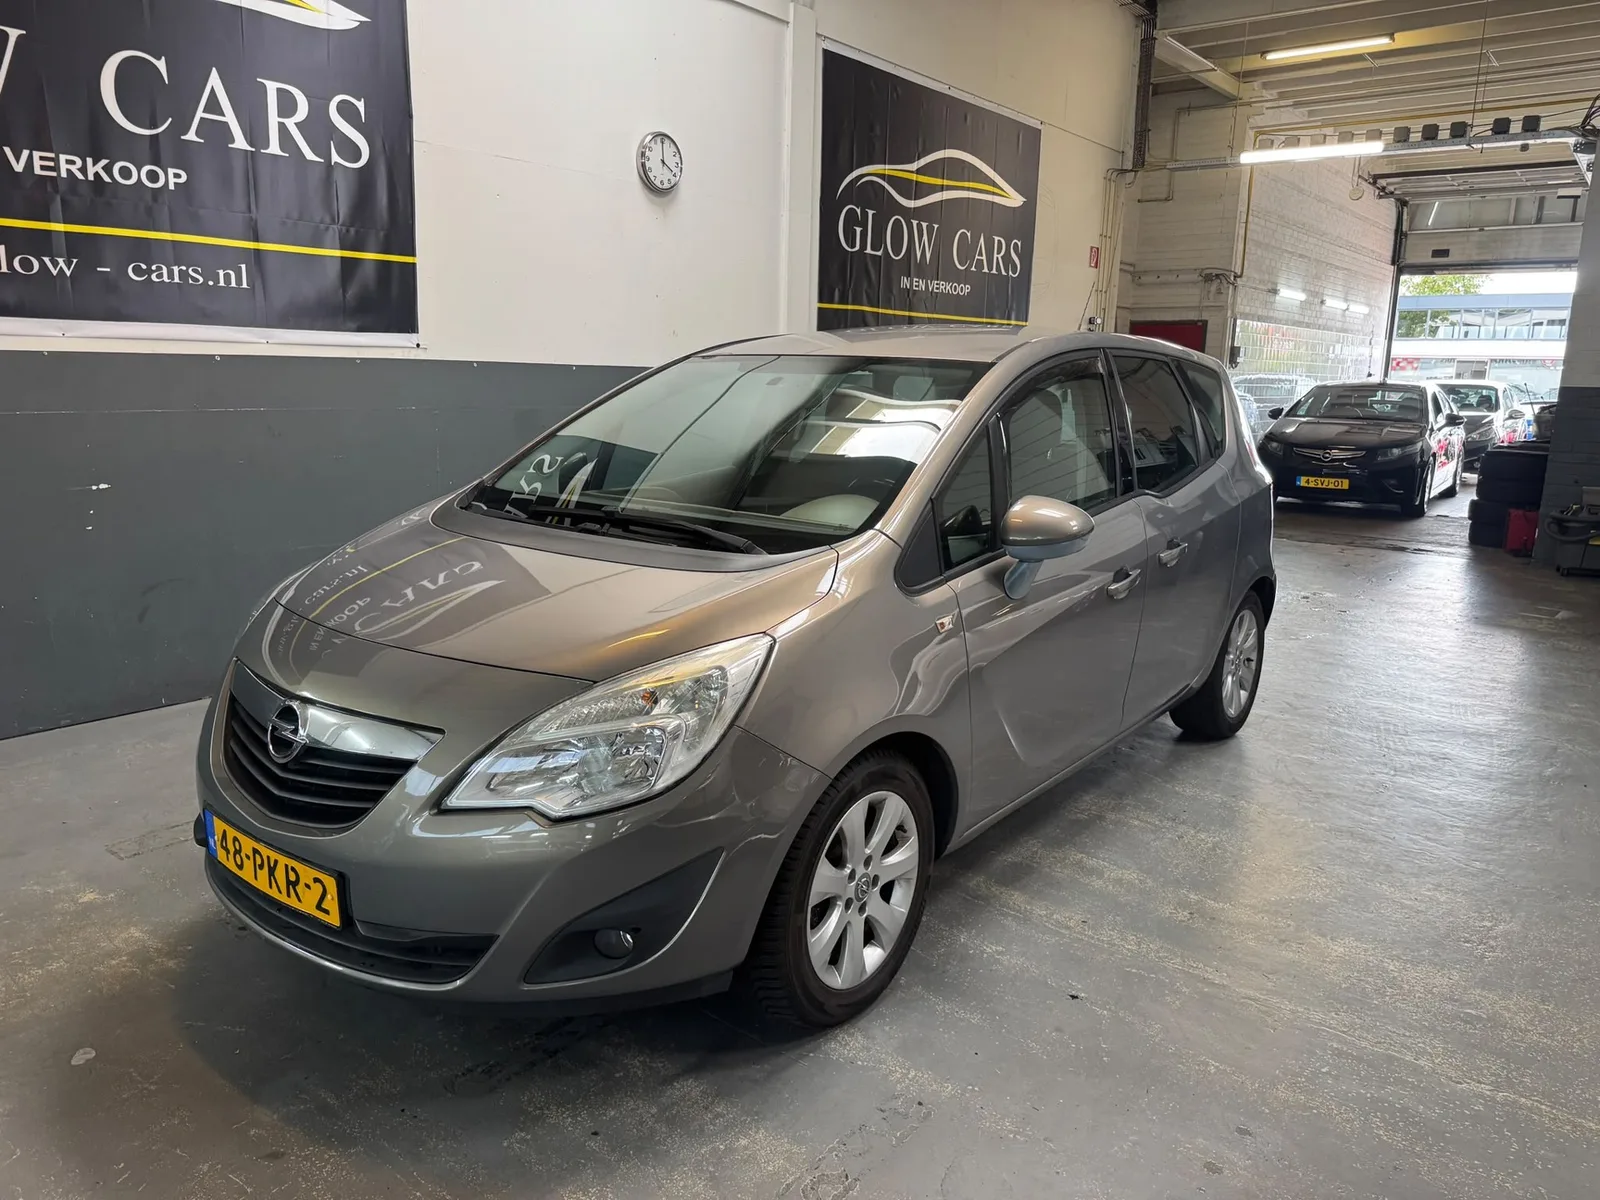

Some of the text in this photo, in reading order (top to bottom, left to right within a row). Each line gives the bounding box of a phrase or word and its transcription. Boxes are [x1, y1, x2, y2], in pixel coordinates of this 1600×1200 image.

[100, 49, 370, 169] CARS
[3, 146, 188, 191] VERKOOP
[838, 204, 1022, 278] GLOW CARS
[127, 261, 251, 289] cars.nl
[900, 275, 971, 296] IN EN VERKOOP
[1304, 478, 1344, 488] 4-SVJ-01
[219, 828, 330, 916] 48-PKR-2
